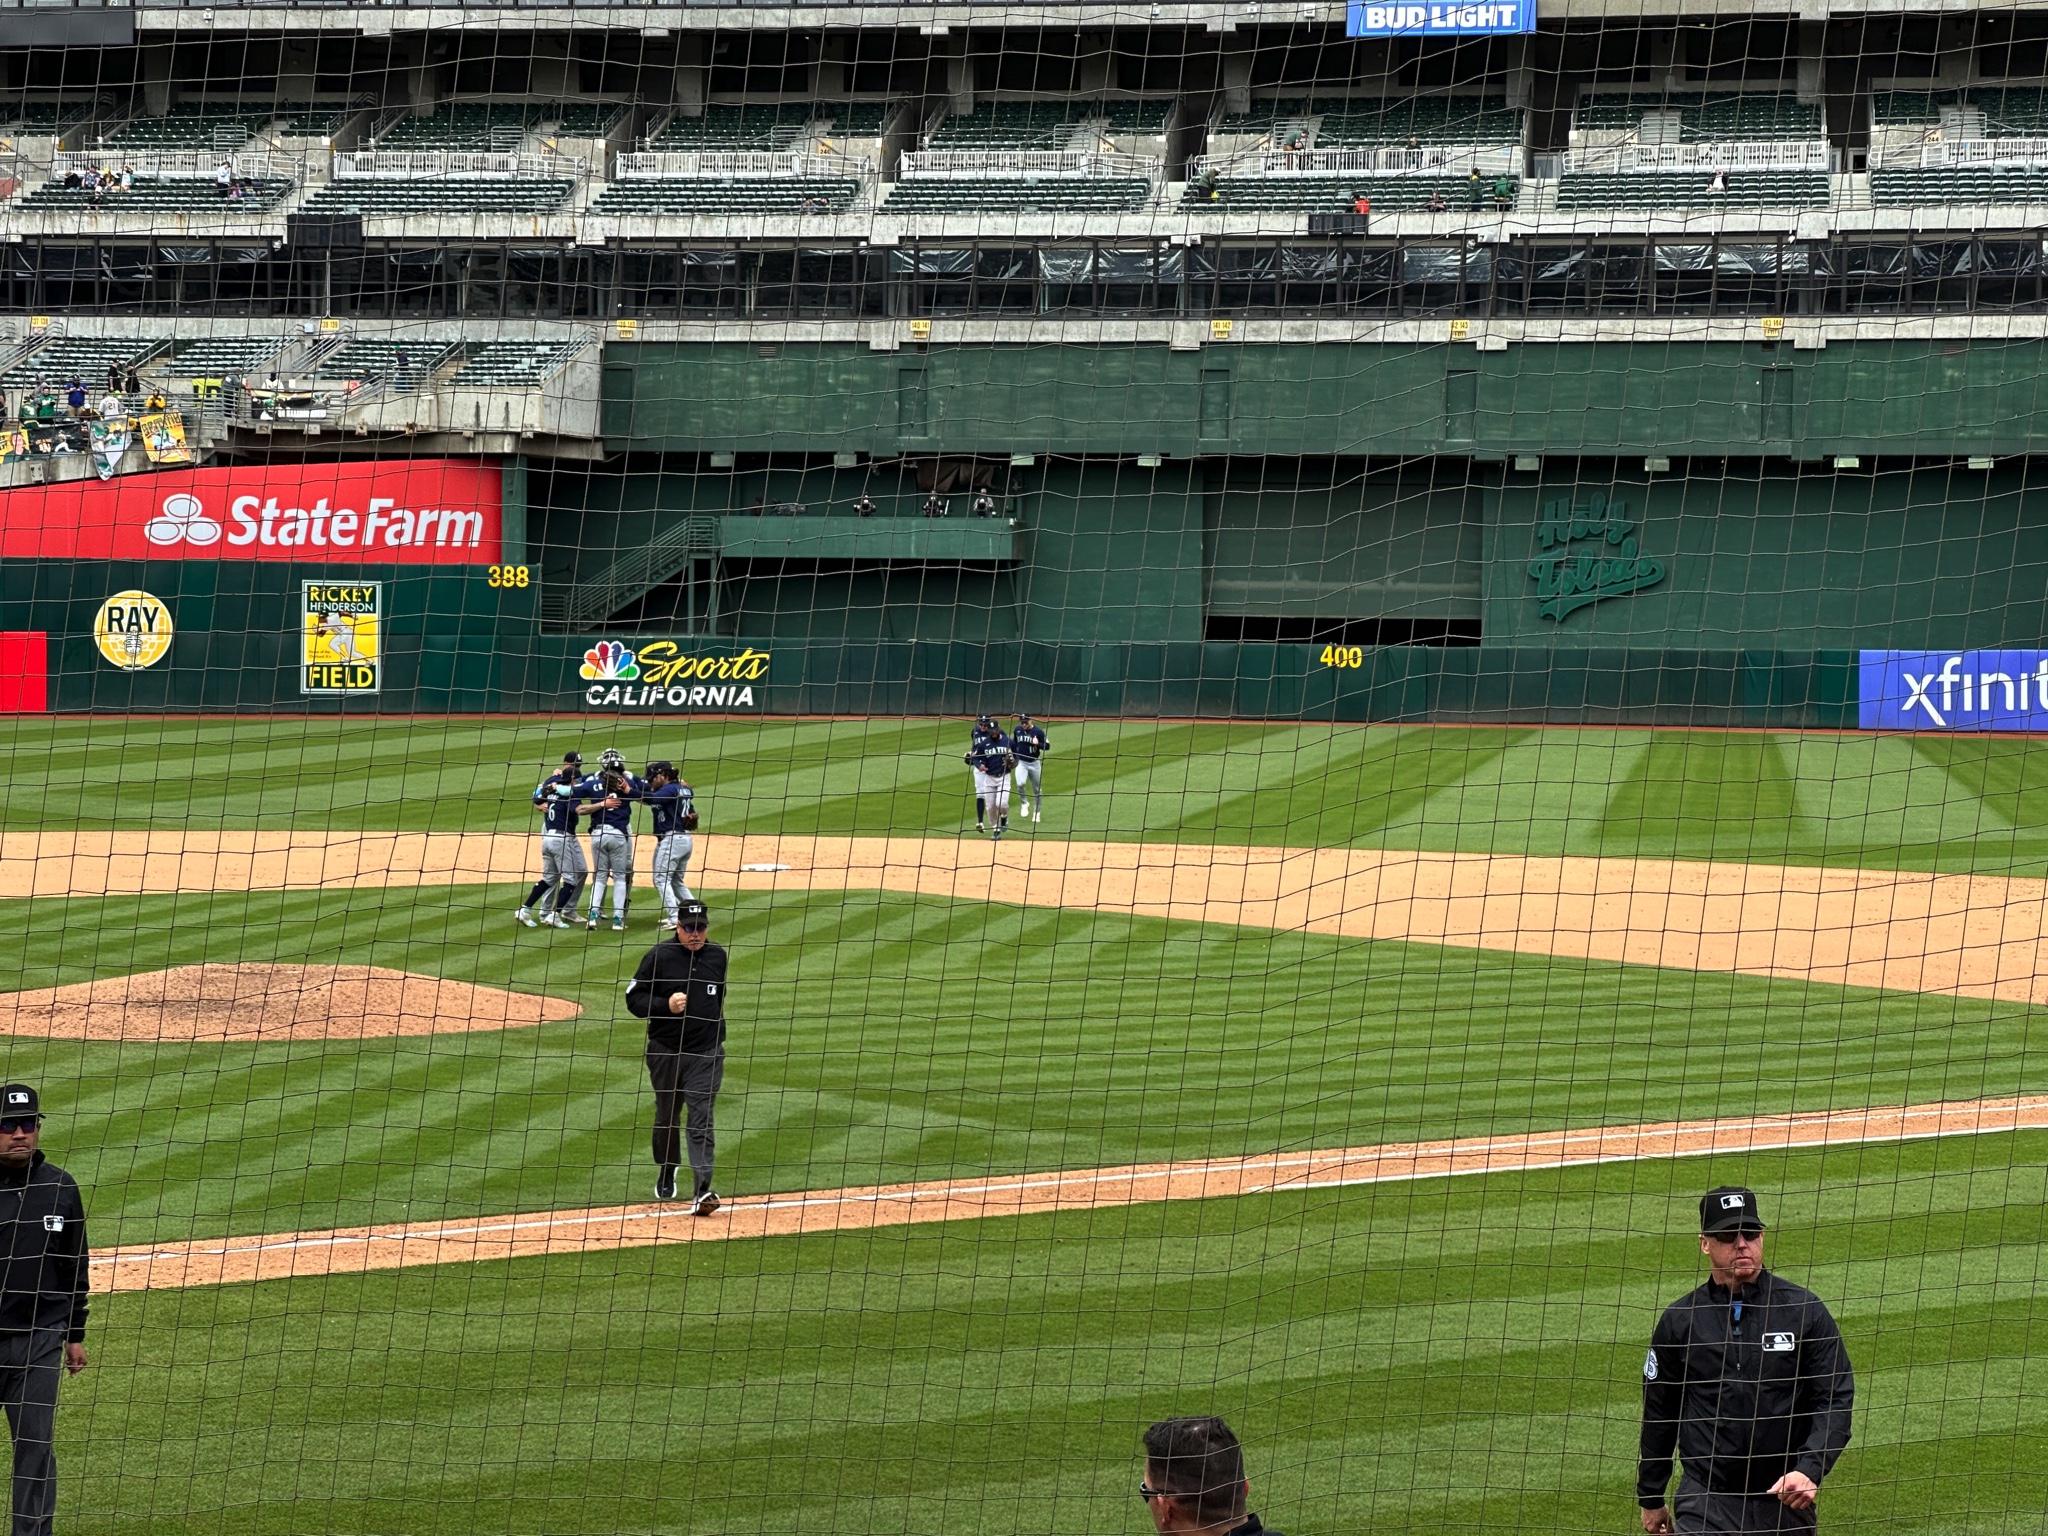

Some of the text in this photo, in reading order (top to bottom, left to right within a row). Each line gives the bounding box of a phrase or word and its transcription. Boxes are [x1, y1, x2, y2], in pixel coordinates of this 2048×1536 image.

[1366, 5, 1517, 29] BUD LIGHT
[1538, 491, 1634, 547] Holy
[488, 565, 529, 588] 388
[310, 586, 373, 602] RICKEY
[310, 602, 374, 612] HENDERSON
[107, 606, 159, 633] RAY
[637, 641, 770, 688] Sports
[1320, 645, 1362, 668] 400
[309, 667, 373, 688] FIELD
[586, 686, 754, 706] CALIFORNIA
[548, 803, 556, 821] 6
